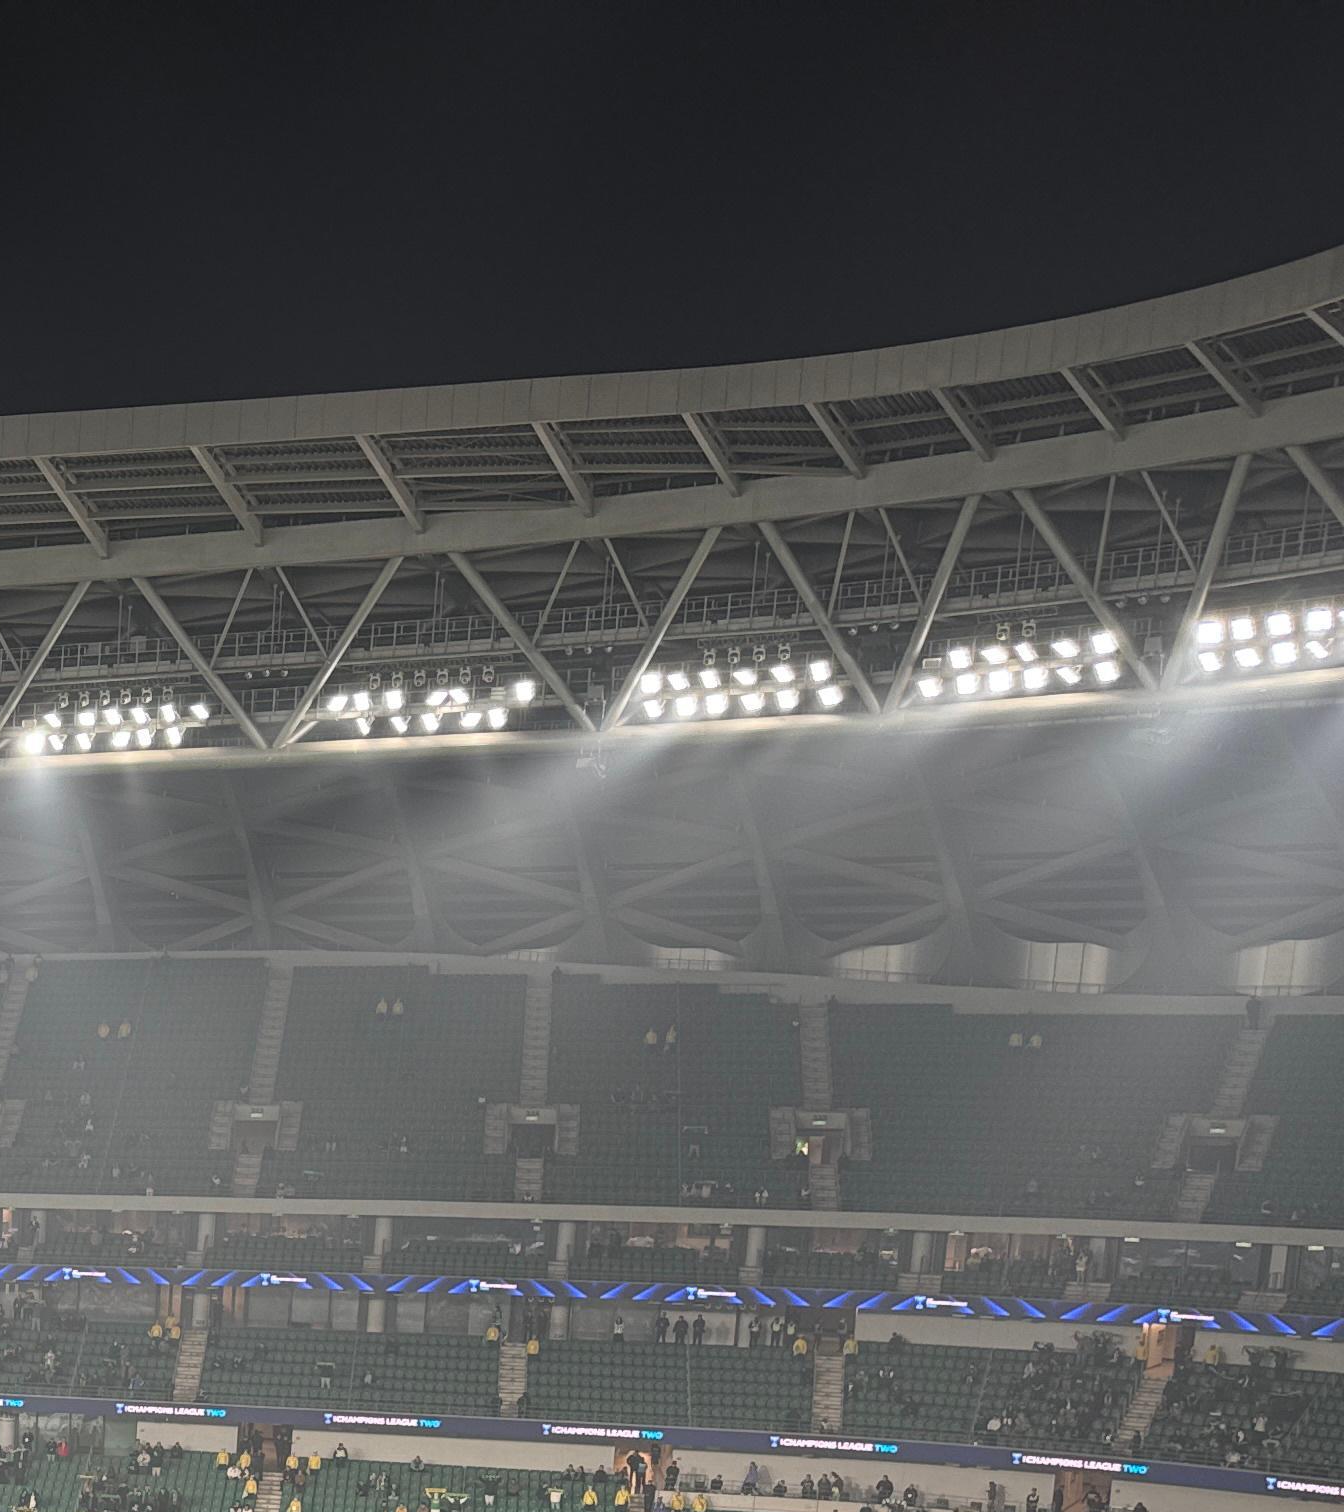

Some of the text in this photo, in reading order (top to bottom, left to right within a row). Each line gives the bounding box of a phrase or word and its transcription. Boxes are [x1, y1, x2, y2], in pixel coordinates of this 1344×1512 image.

[207, 1409, 225, 1418] TWO
[420, 1419, 440, 1428] TWO
[642, 1430, 663, 1440] TWO
[838, 1441, 873, 1452] LEAGUE
[875, 1444, 897, 1453] TWO
[1027, 1455, 1147, 1474] CHAMPIONS LEAGUE TWO
